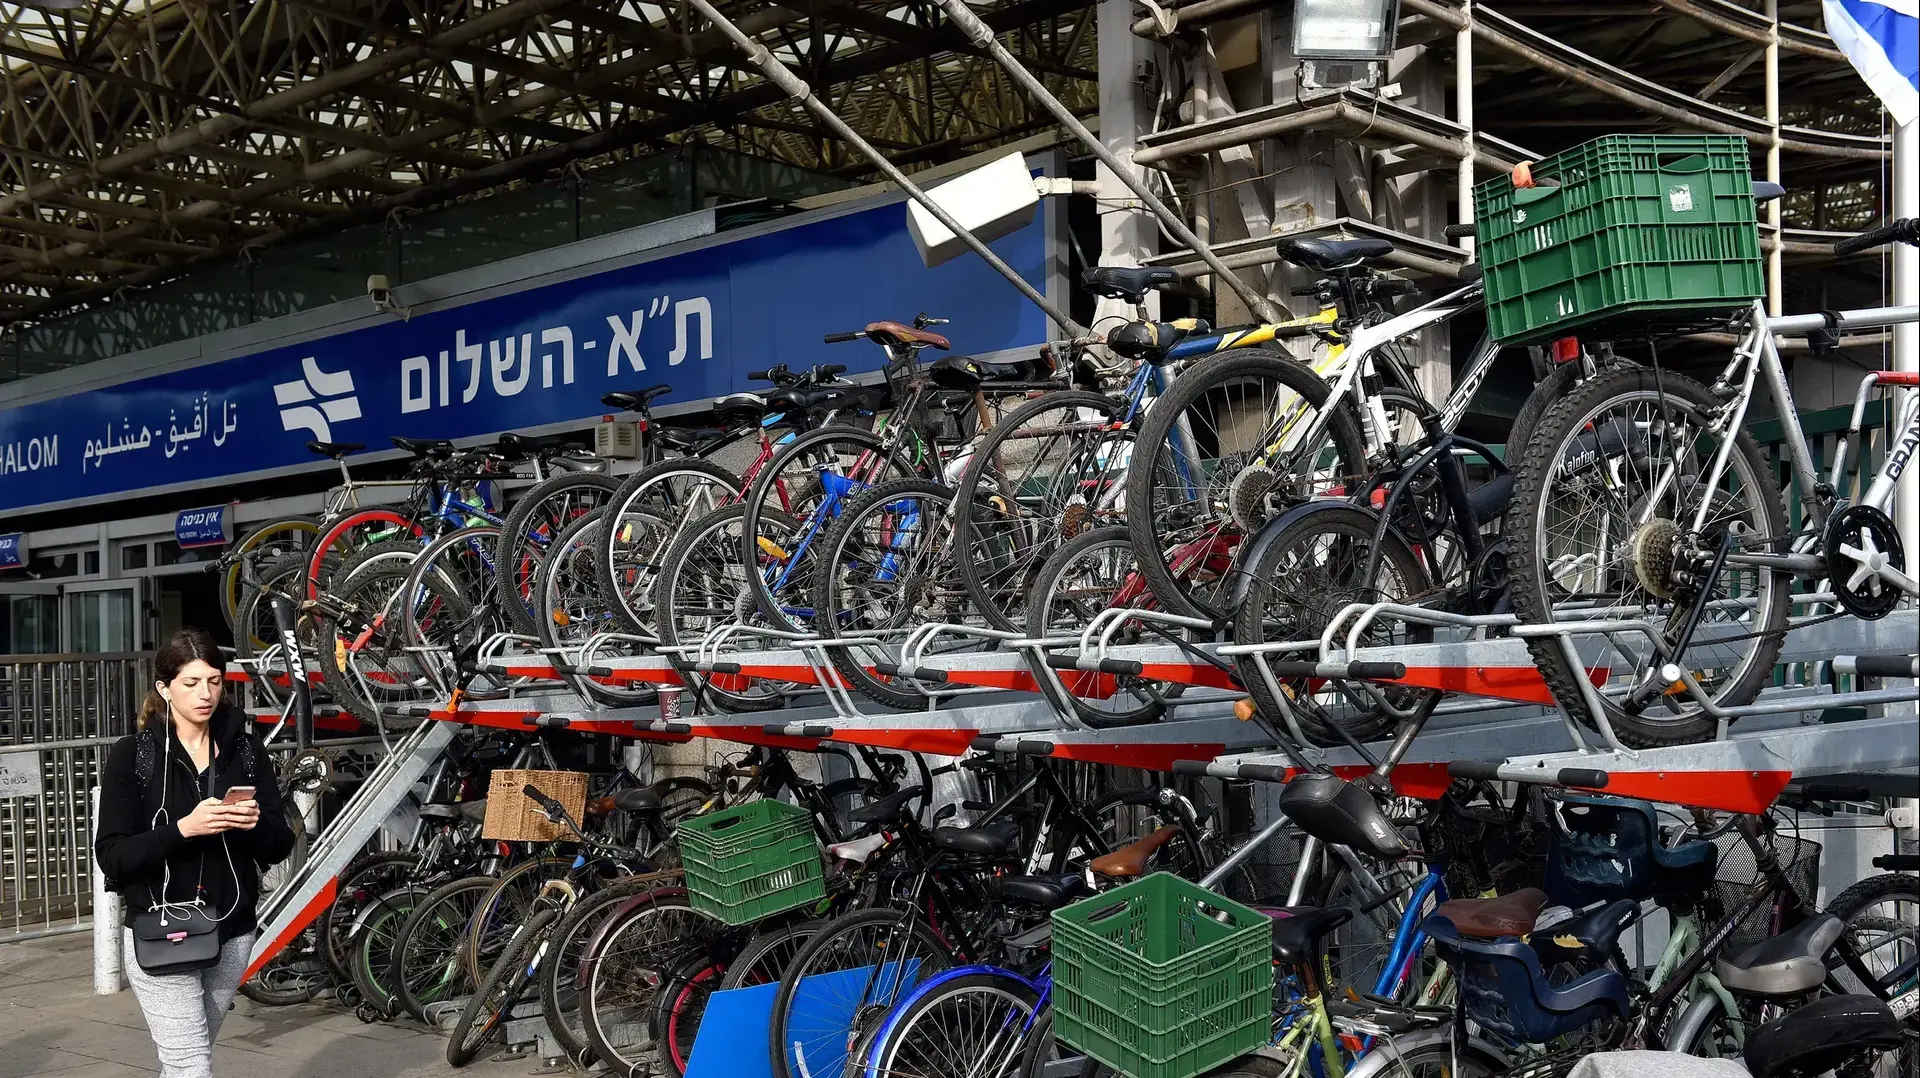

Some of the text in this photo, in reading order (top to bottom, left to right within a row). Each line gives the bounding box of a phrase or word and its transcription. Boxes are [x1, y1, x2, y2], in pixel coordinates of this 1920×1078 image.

[213, 399, 237, 447] تل
[180, 511, 219, 527] אין כניסה
[1703, 921, 1733, 957] IGUANA
